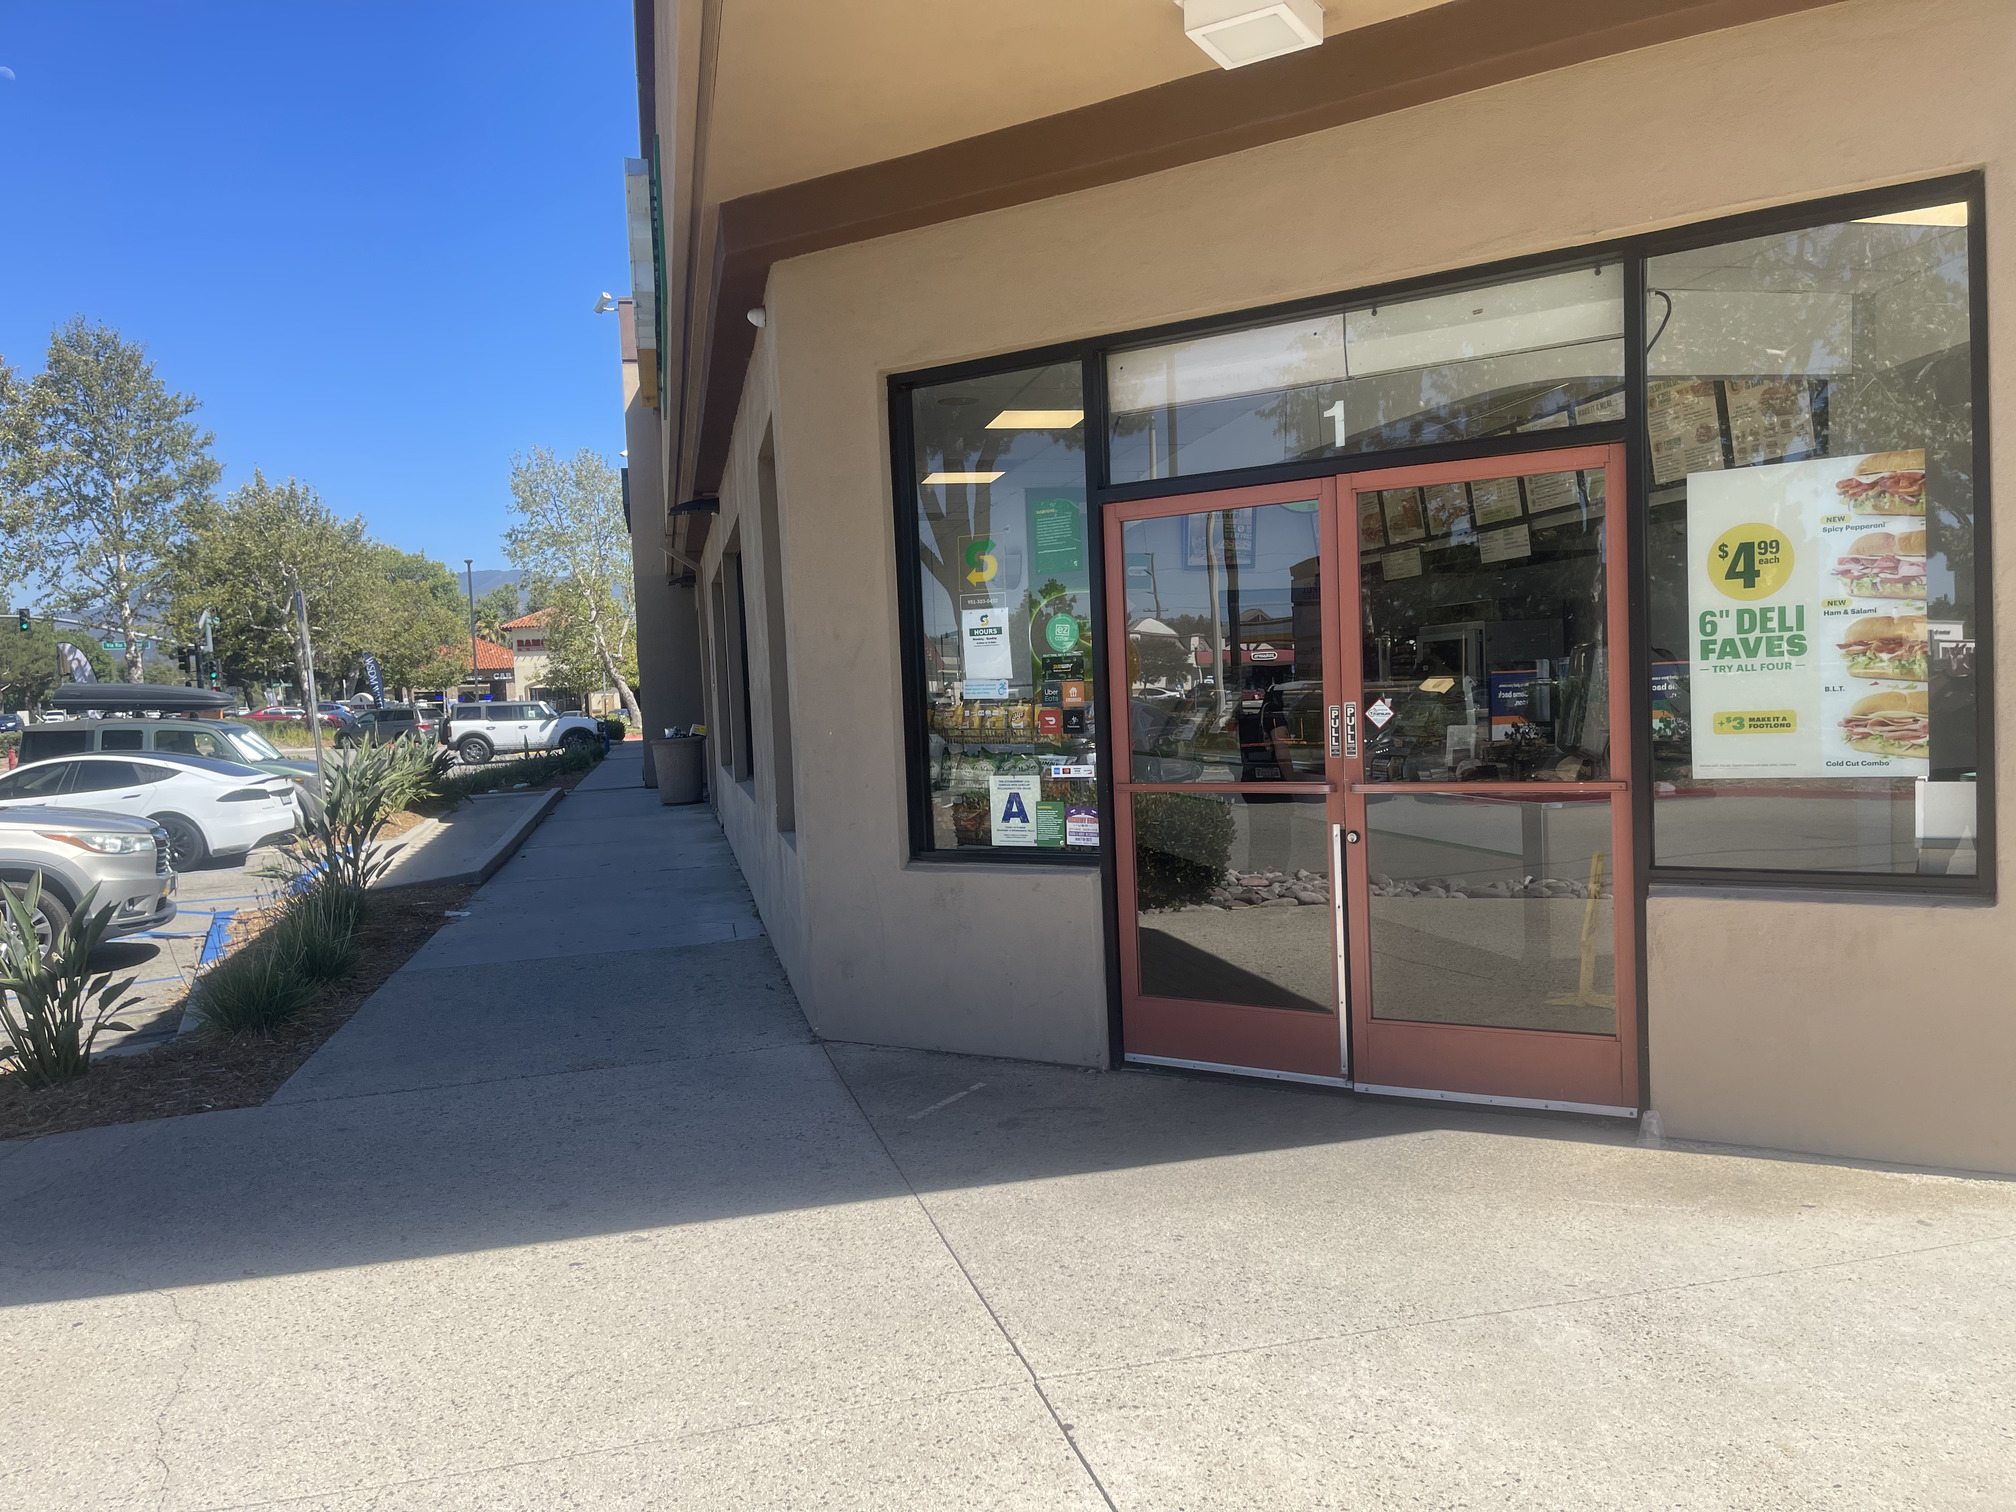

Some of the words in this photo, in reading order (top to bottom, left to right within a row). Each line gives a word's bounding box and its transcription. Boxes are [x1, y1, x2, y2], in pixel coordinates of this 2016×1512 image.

[1323, 400, 1346, 447] 1
[1822, 525, 1844, 533] Spicy
[1845, 521, 1886, 532] Pepperoni
[1758, 556, 1780, 565] each
[1736, 605, 1804, 635] DELI
[1823, 609, 1842, 617] Ham
[1850, 607, 1877, 615] Salami
[1057, 626, 1068, 634] ez
[1700, 634, 1808, 661] FAVES
[1712, 665, 1733, 673] TRY
[1736, 663, 1758, 672] ALL
[1760, 662, 1793, 671] FOUR
[1331, 710, 1339, 746] PULL
[1346, 707, 1355, 743] PULL
[1001, 791, 1031, 824] A
